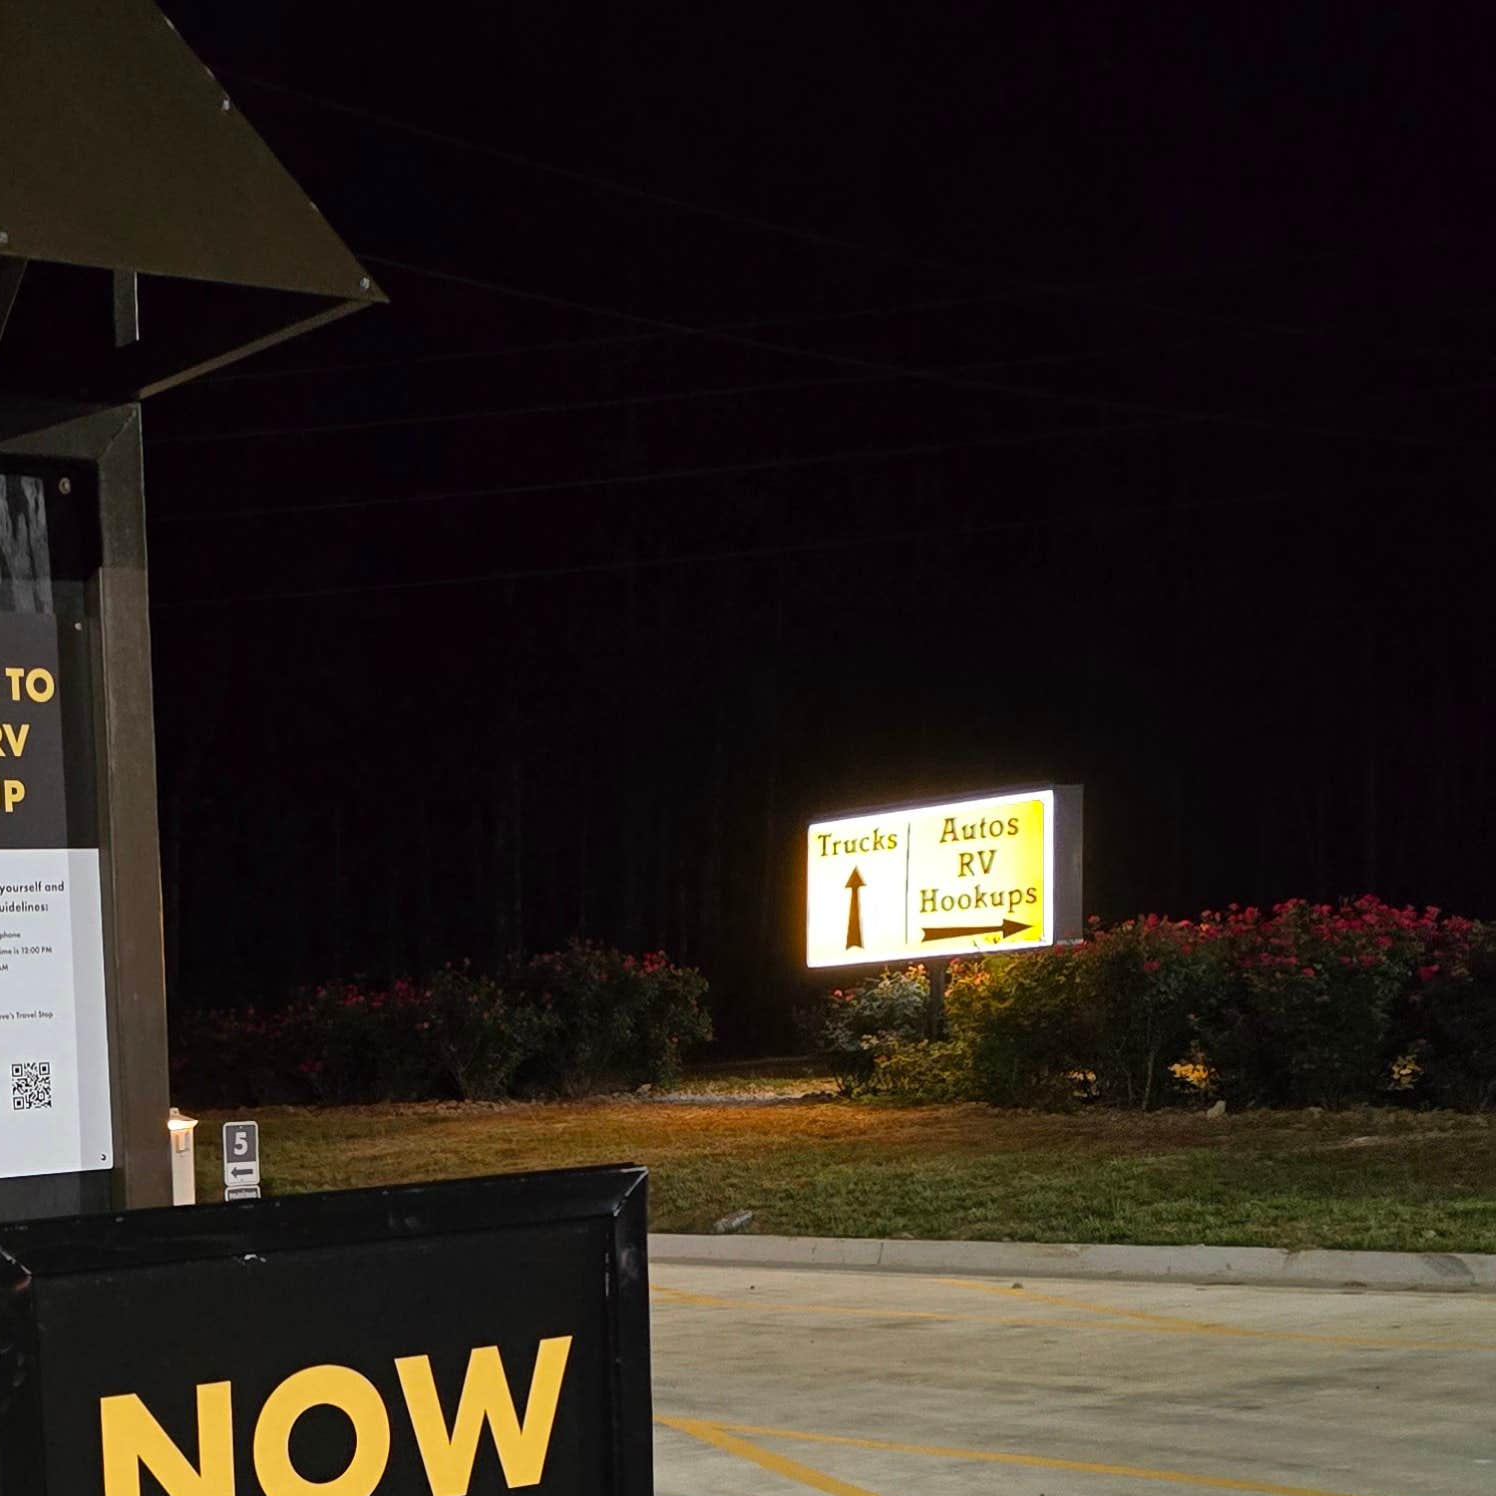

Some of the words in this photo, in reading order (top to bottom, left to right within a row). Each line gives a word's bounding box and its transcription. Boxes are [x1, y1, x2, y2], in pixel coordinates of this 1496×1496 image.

[5, 668, 54, 702] TO
[818, 828, 898, 856] Trucks
[940, 817, 1020, 844] Autos
[958, 850, 997, 878] RV
[0, 881, 41, 896] yourself
[45, 881, 64, 892] and
[920, 884, 1037, 914] Hookups
[0, 931, 21, 939] phone
[16, 1011, 36, 1019] Travel
[39, 1011, 53, 1019] Stop
[234, 1132, 248, 1155] 5
